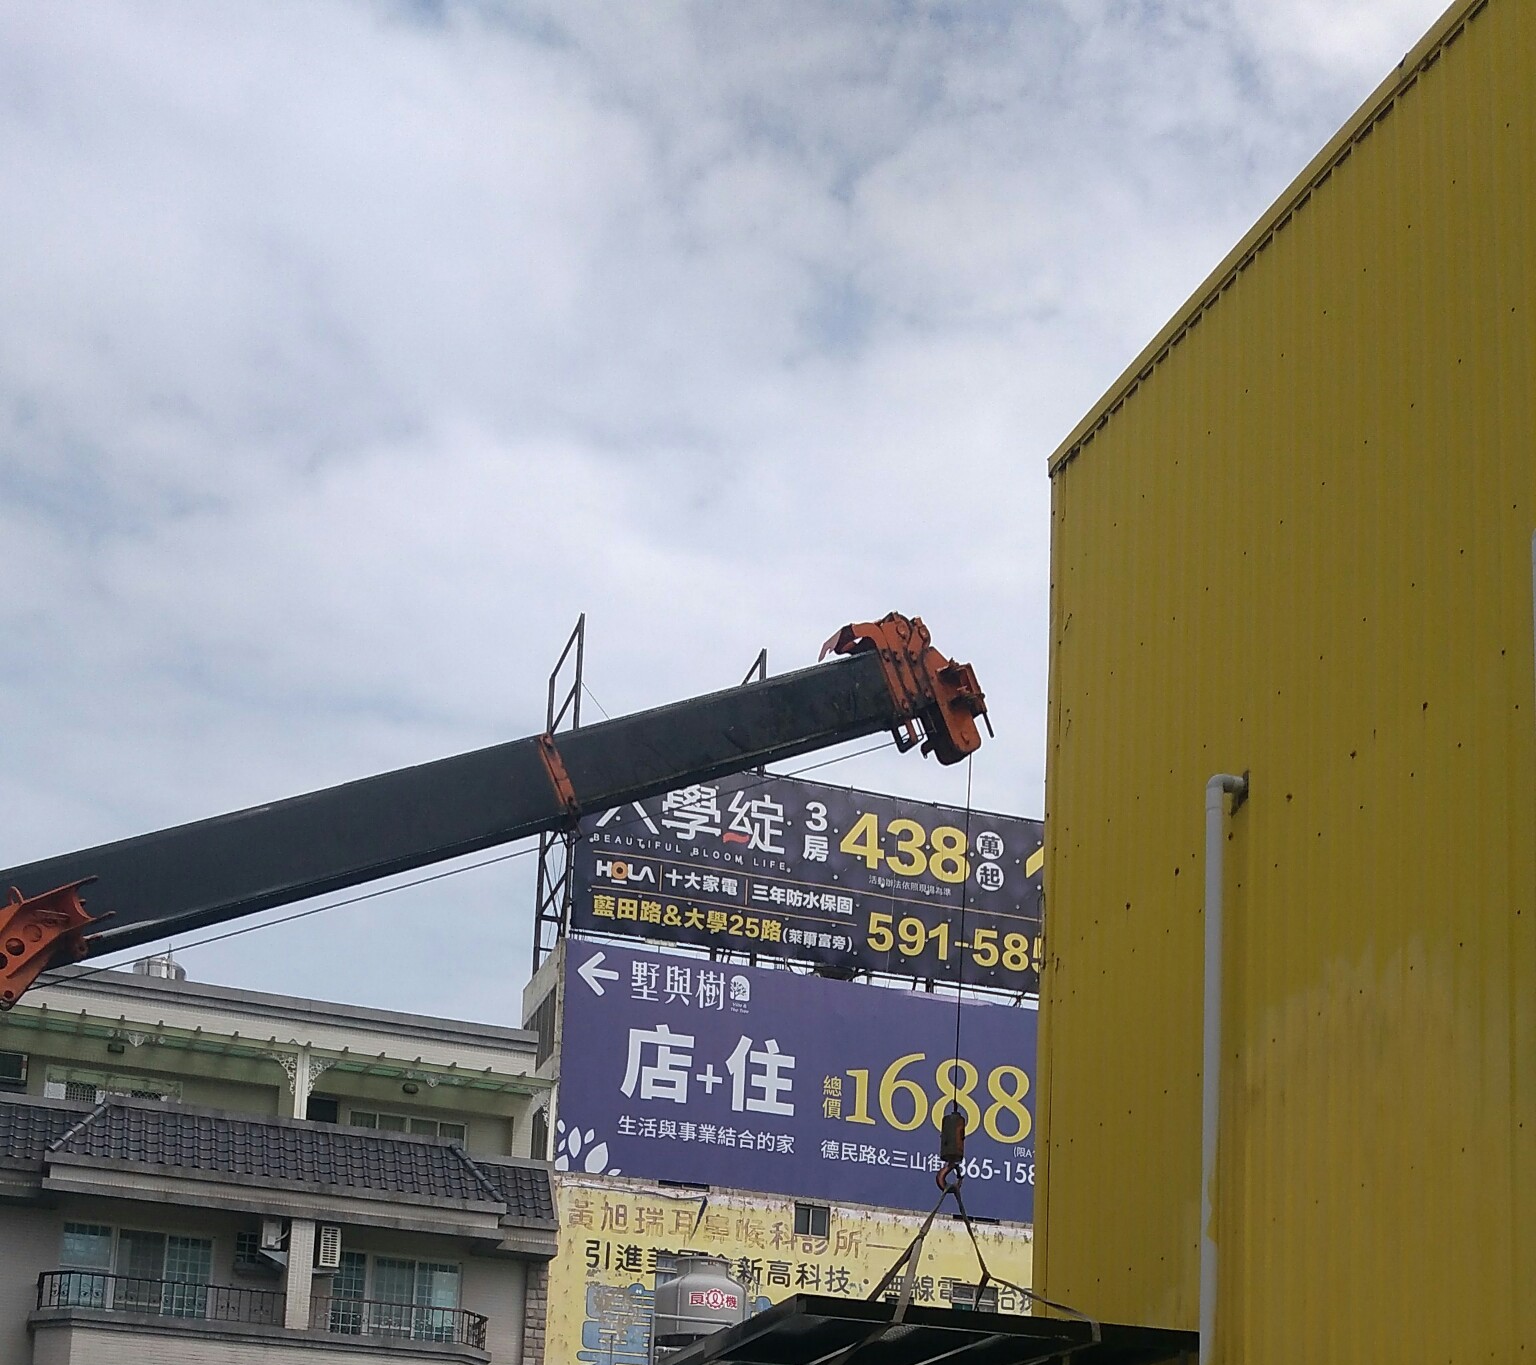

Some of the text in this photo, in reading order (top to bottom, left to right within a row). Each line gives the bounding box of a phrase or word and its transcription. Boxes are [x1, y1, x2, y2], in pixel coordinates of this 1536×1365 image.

[593, 833, 682, 854] BEAUTIFUL
[692, 847, 743, 865] BLOOM
[839, 812, 971, 883] 438
[596, 859, 656, 885] HOLA
[751, 883, 854, 915] 三年防水保固
[822, 1075, 843, 1121] 總價
[845, 1053, 1032, 1144] 1688
[617, 1115, 796, 1155] 生活與事業結合的家
[820, 1139, 945, 1172] 德民路&三山街
